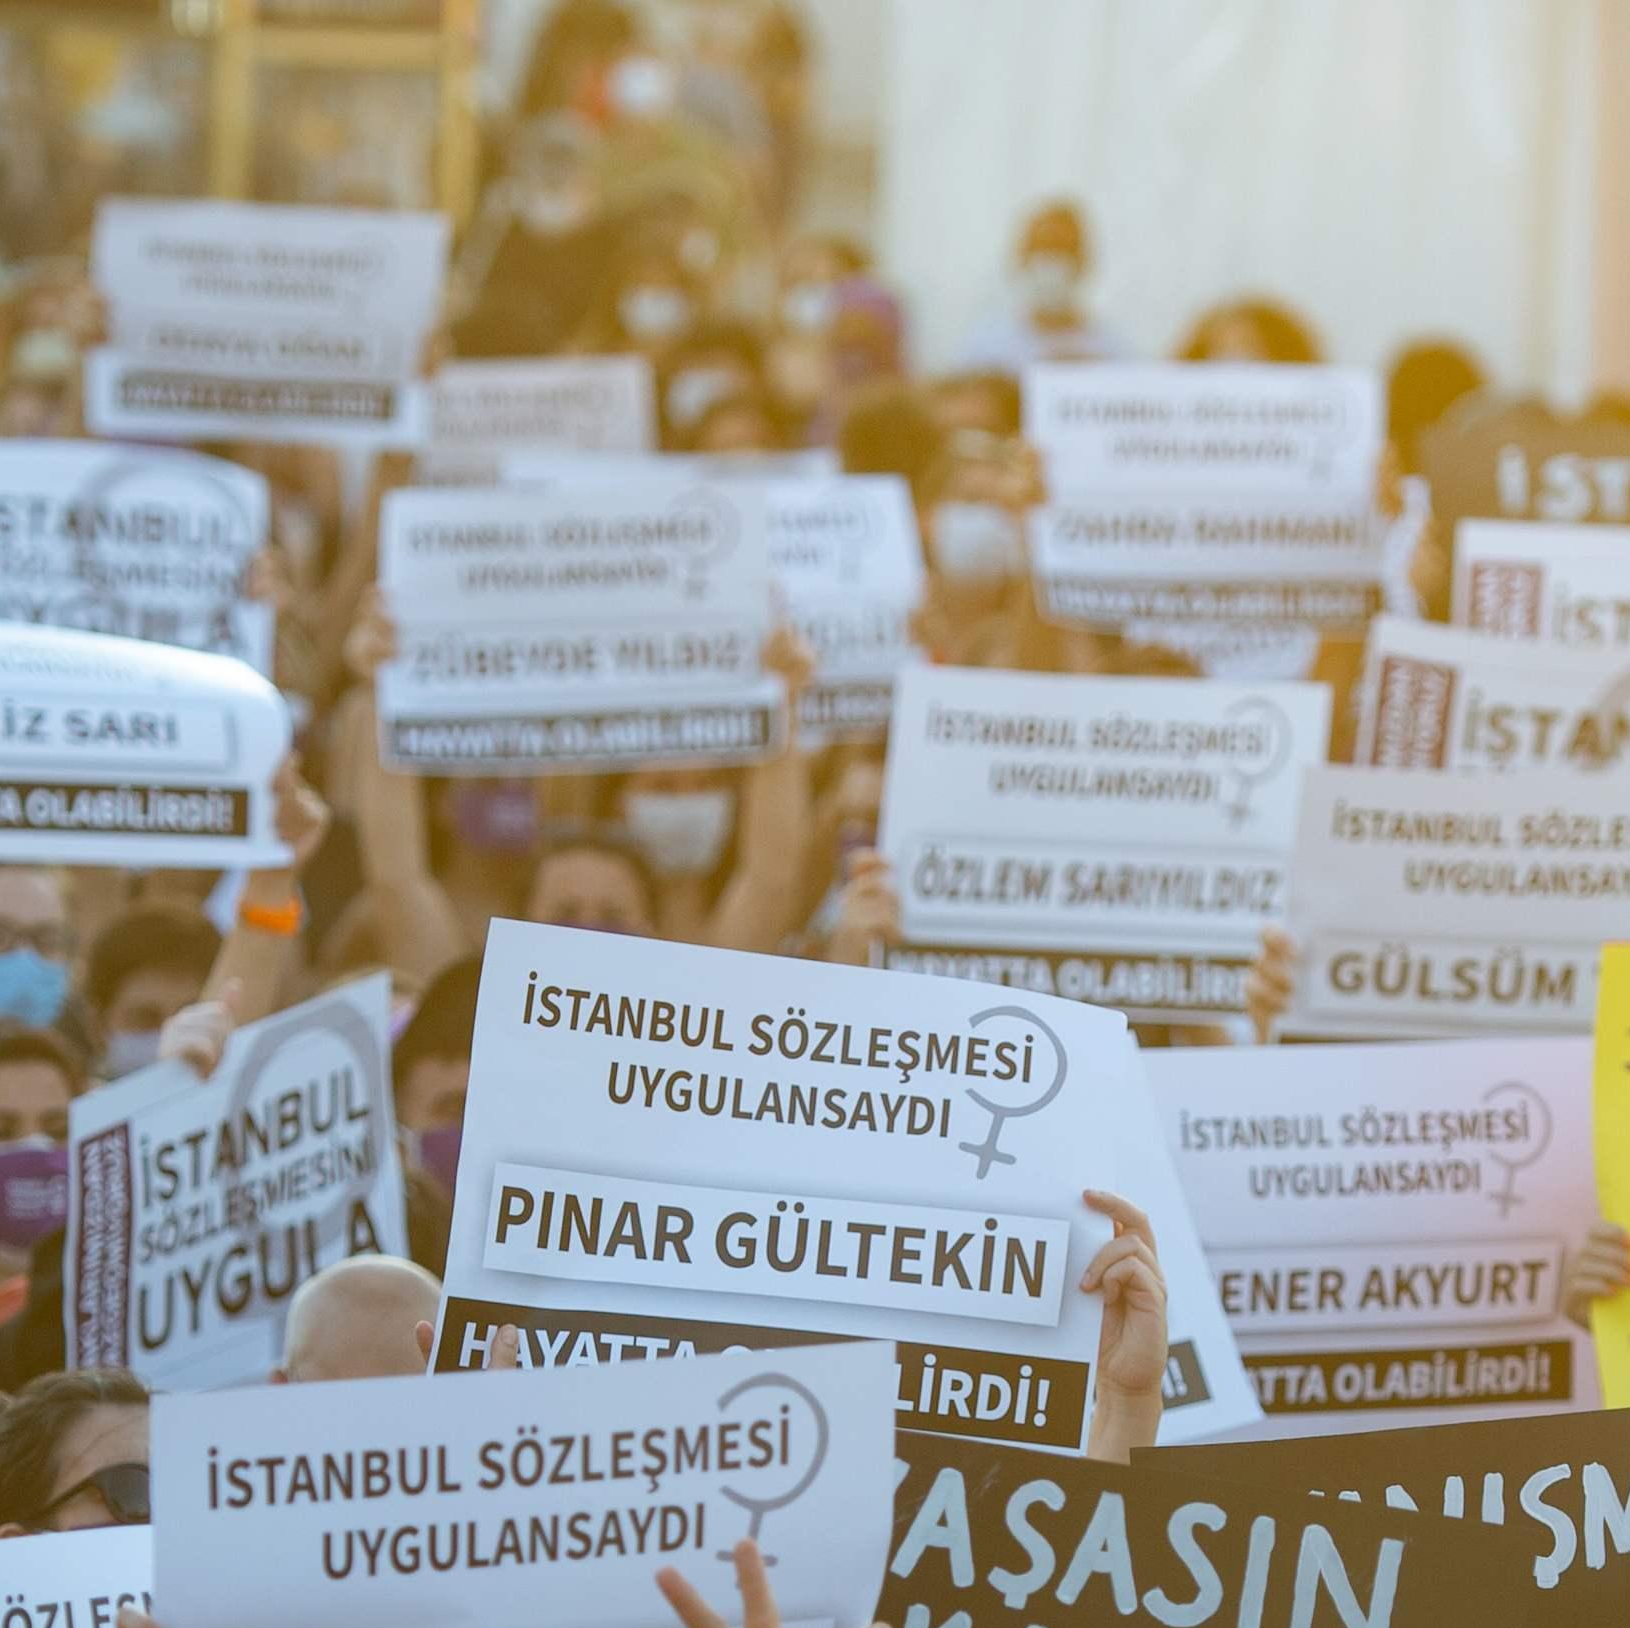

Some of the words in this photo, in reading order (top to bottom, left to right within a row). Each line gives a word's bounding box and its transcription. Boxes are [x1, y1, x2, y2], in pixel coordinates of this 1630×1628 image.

[65, 705, 180, 750] SARI
[1331, 800, 1510, 852] İSTANBUL
[912, 840, 1056, 902] ÖZLEM
[1065, 862, 1285, 916] SARIYILDIZ
[1327, 946, 1579, 1006] GÜLSÜM
[521, 970, 735, 1053] İSTANBUL
[748, 1007, 1035, 1085] SÖZLEŞMESİ
[139, 1062, 370, 1210] İSTANBUL
[607, 1060, 953, 1140] UYGULANSAYDI
[1180, 1109, 1332, 1152] İSTANBUL
[1341, 1101, 1532, 1152] SÖZLEŞMESİ
[1248, 1160, 1482, 1199] UYGULANSAYDI
[137, 1198, 383, 1353] UYGULA
[493, 1184, 695, 1265] PINAR
[715, 1198, 1049, 1300] GÜLTEKİN
[1357, 1258, 1549, 1311] AKYURT
[1333, 1346, 1551, 1400] OLABİLİRDİ!
[207, 1446, 461, 1510] İSTANBUL
[476, 1405, 791, 1493] SÖZLEŞMESİ
[321, 1502, 706, 1580] UYGULANSAYDI
